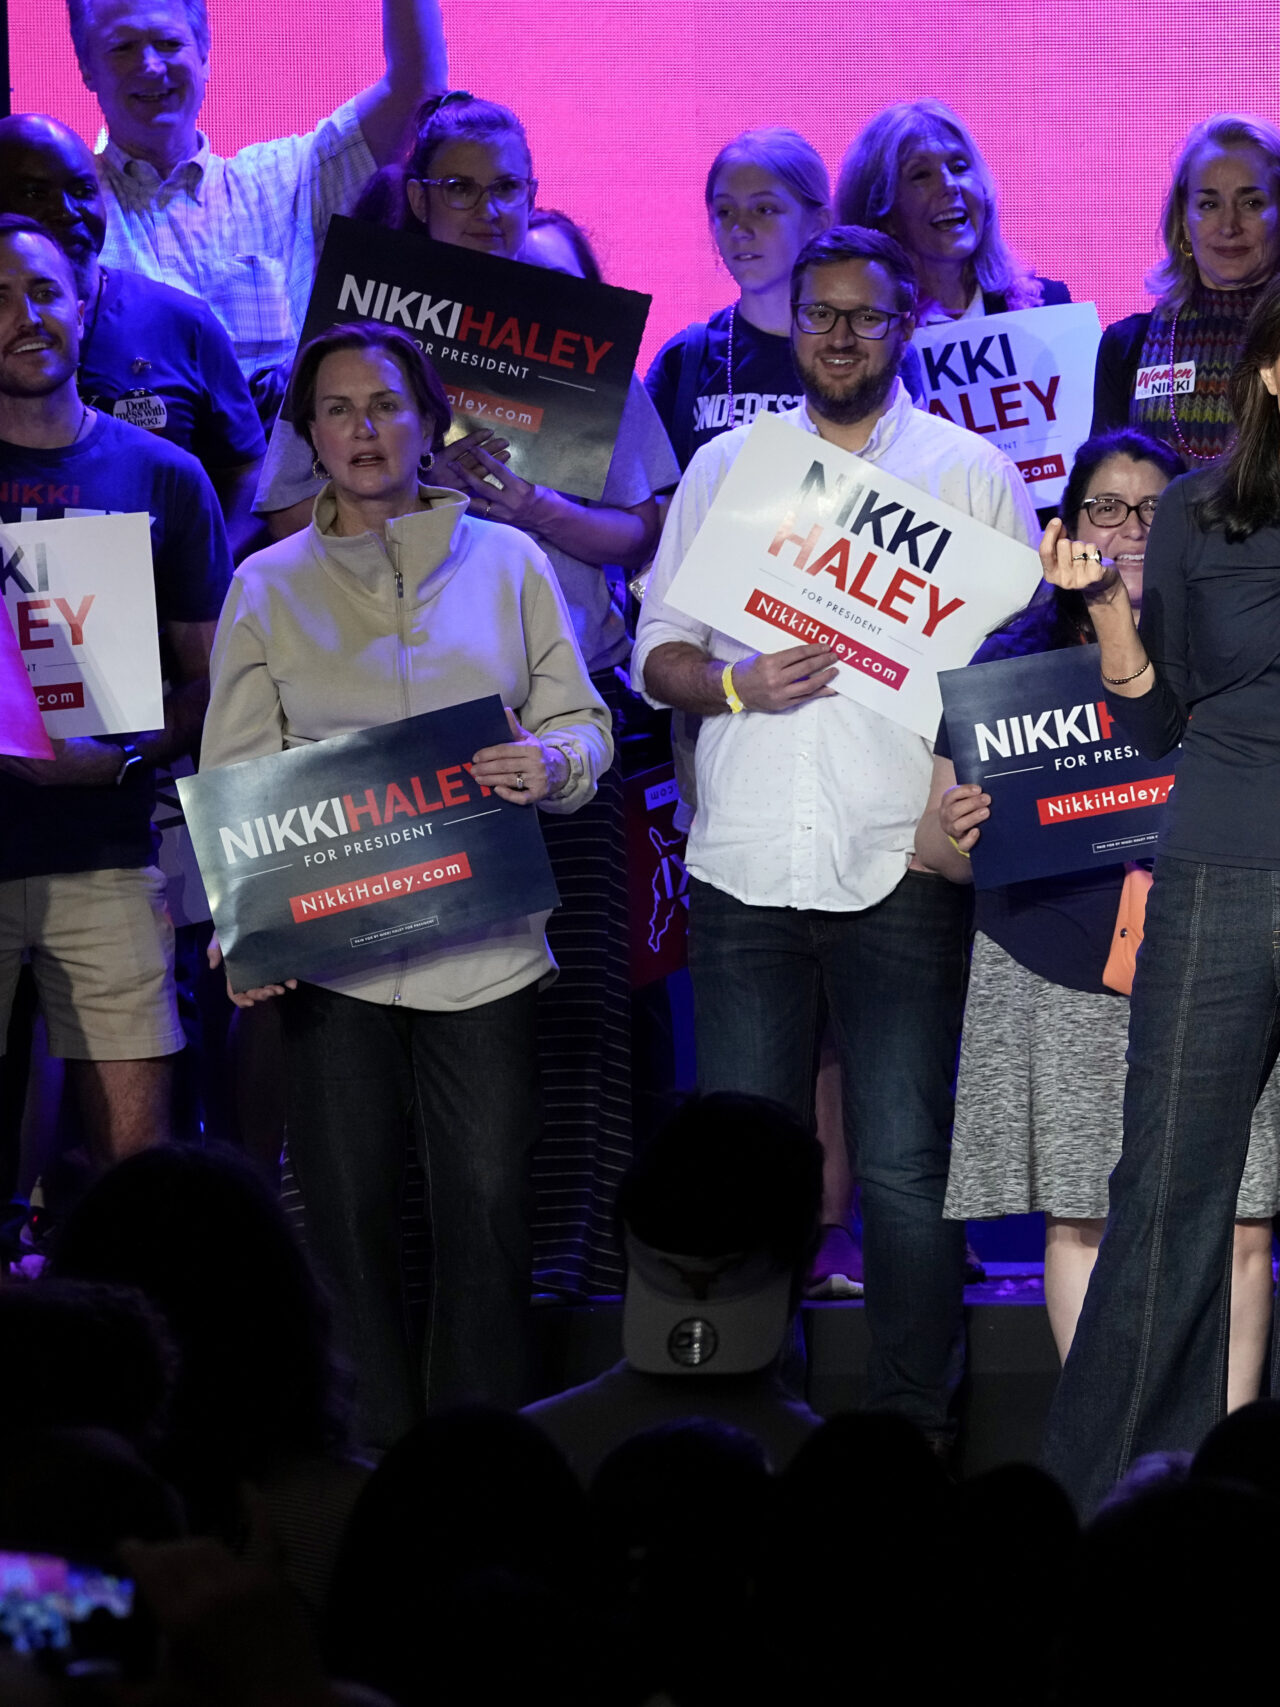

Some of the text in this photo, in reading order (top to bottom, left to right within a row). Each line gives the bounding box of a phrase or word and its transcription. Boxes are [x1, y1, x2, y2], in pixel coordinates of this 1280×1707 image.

[413, 339, 529, 379] OR PRESIDENT
[768, 511, 966, 637] HALEY
[801, 588, 882, 635] FOR PRESIDENT
[756, 597, 897, 682] NikkiHaley.com
[1054, 745, 1140, 771] FOR PRES
[304, 822, 434, 868] FOR PRESIDENT
[301, 862, 461, 914] NikkiHaley.com
